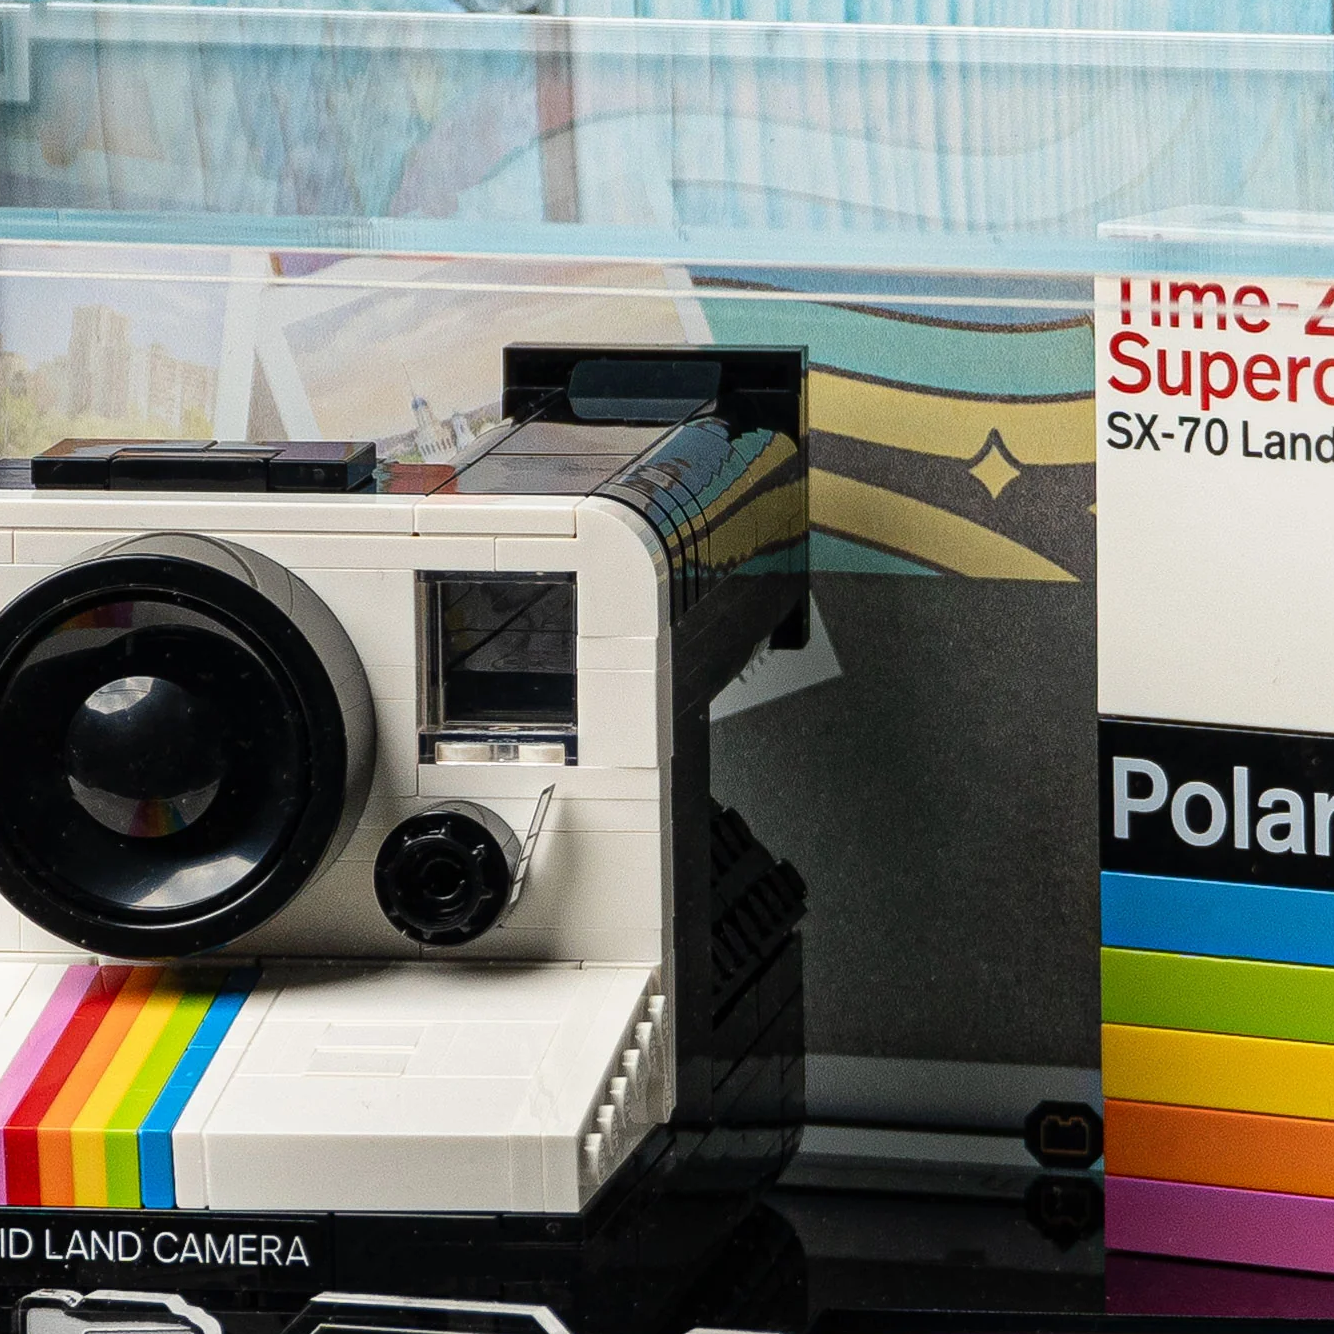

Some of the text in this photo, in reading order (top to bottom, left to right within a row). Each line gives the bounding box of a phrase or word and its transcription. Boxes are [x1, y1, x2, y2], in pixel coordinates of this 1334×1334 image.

[1106, 411, 1230, 456] SX-70
[44, 1227, 146, 1264] LAND
[152, 1231, 310, 1268] CAMERA
